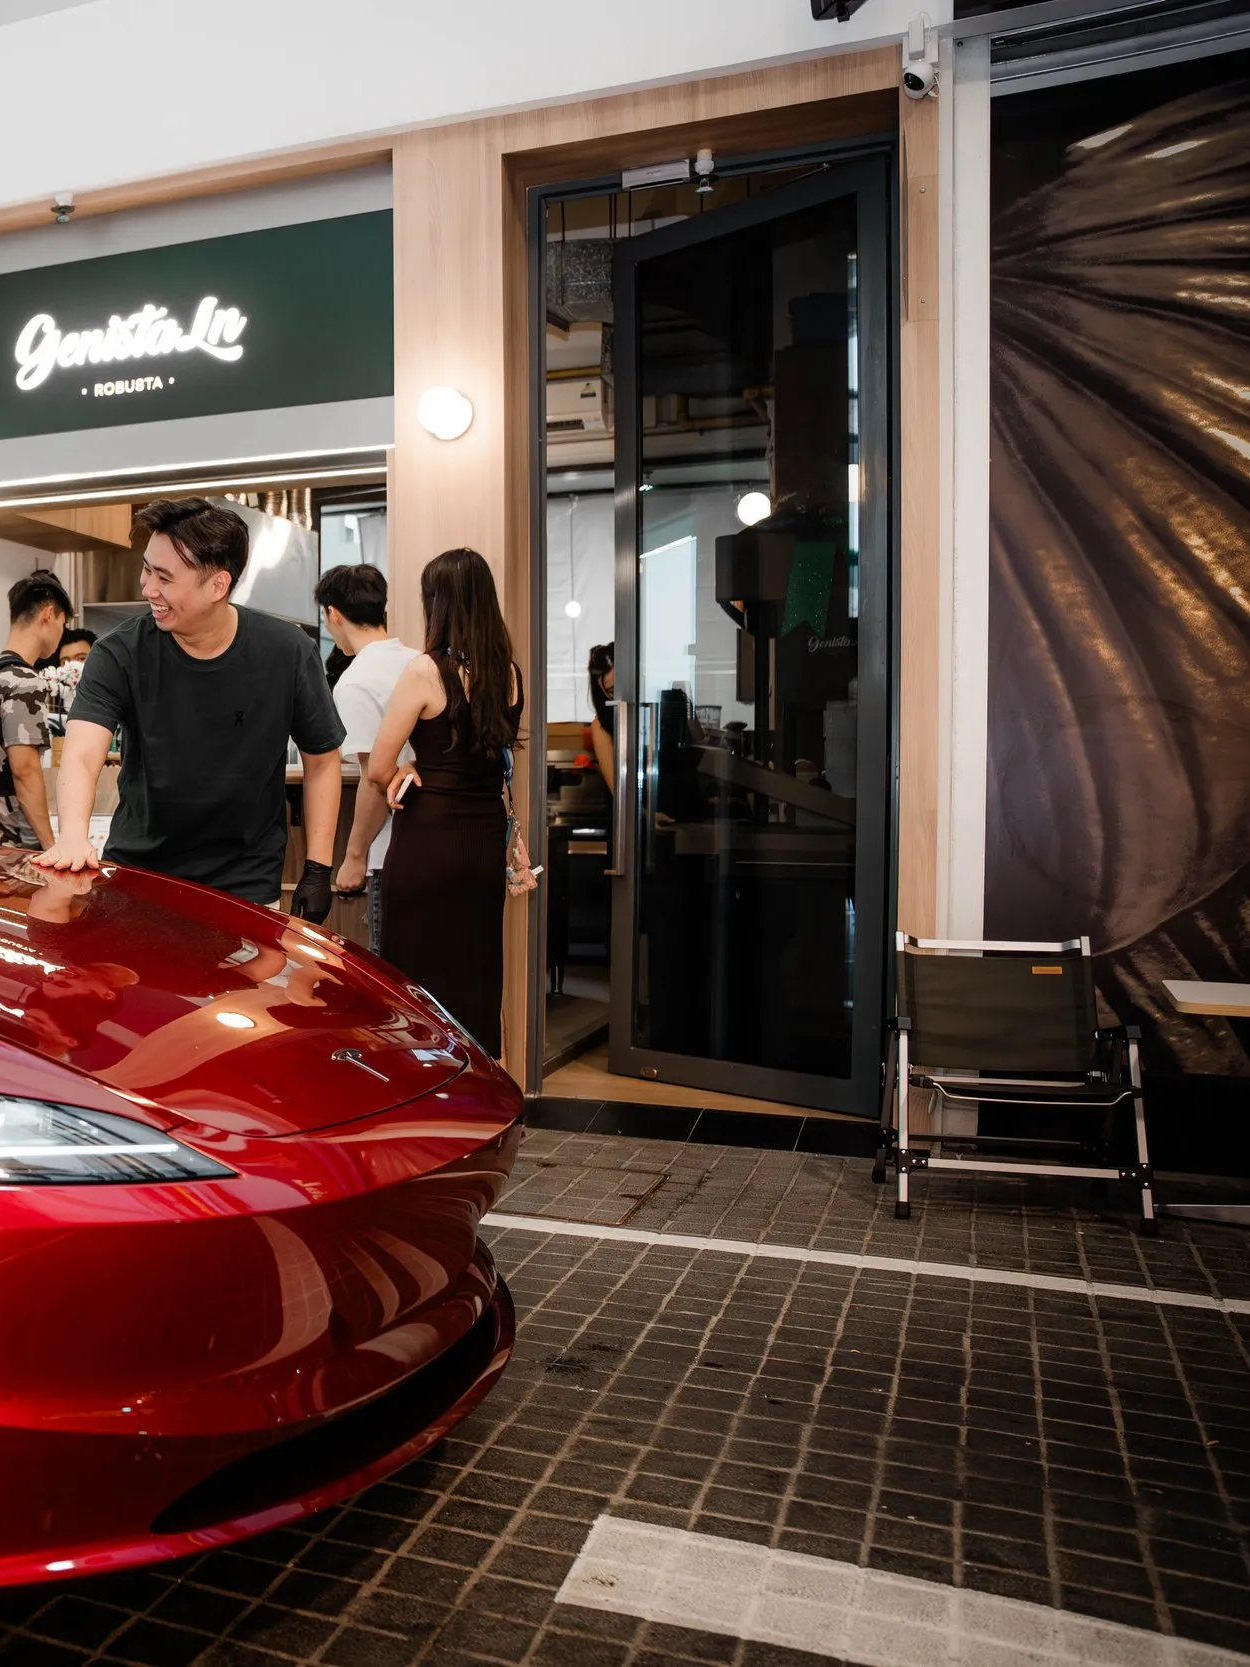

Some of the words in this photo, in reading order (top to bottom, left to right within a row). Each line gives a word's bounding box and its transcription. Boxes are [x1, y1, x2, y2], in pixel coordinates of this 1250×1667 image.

[15, 304, 186, 391] Genista
[180, 296, 248, 361] Ln
[94, 376, 164, 397] ROBUSTA
